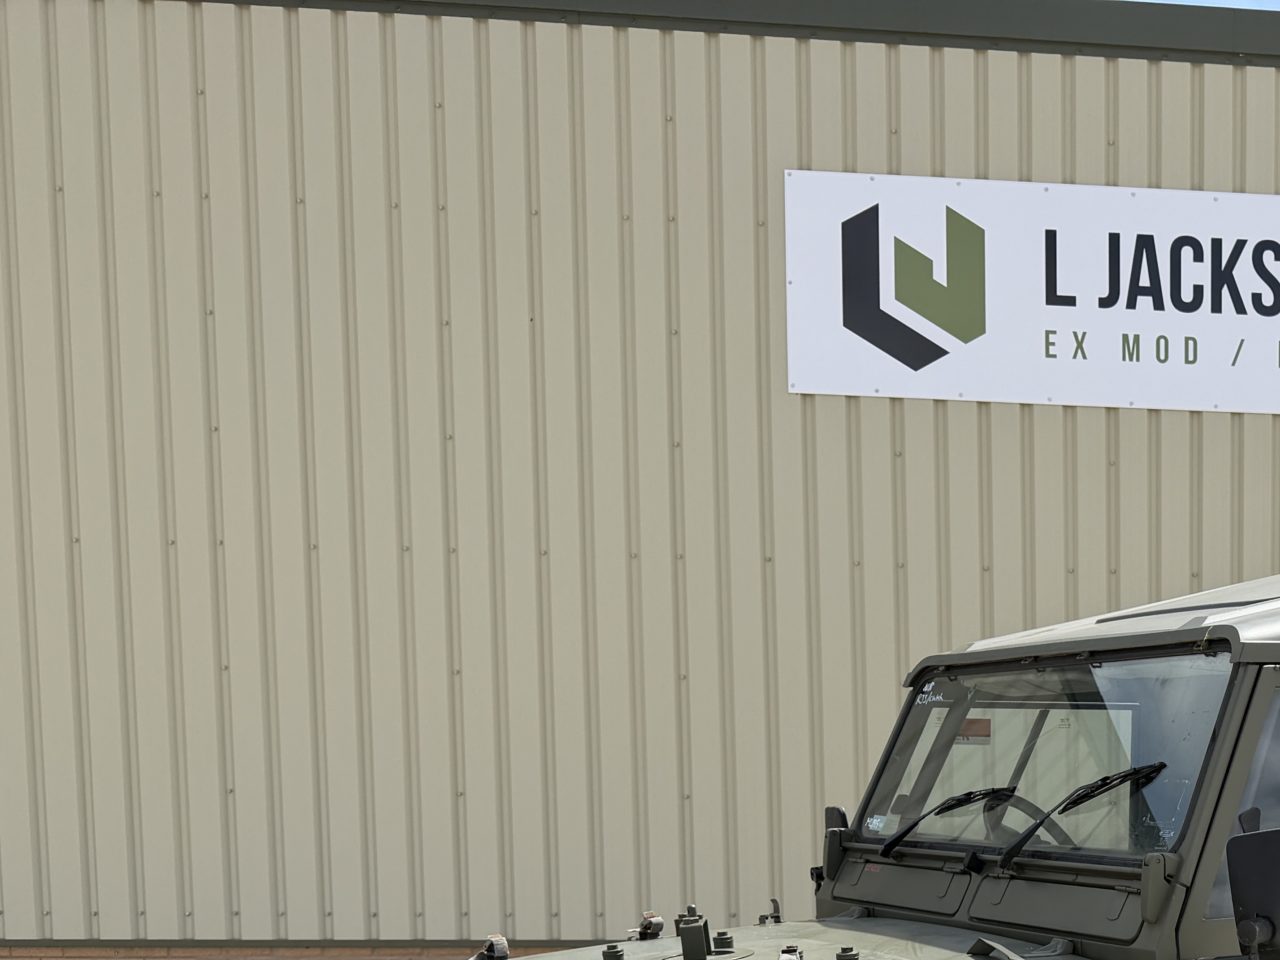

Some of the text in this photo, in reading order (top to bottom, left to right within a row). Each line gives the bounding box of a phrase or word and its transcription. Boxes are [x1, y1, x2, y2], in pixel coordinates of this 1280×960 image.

[1044, 228, 1077, 308] L
[1044, 329, 1088, 360] EX
[1121, 333, 1198, 365] MOD
[1231, 338, 1245, 367] /
